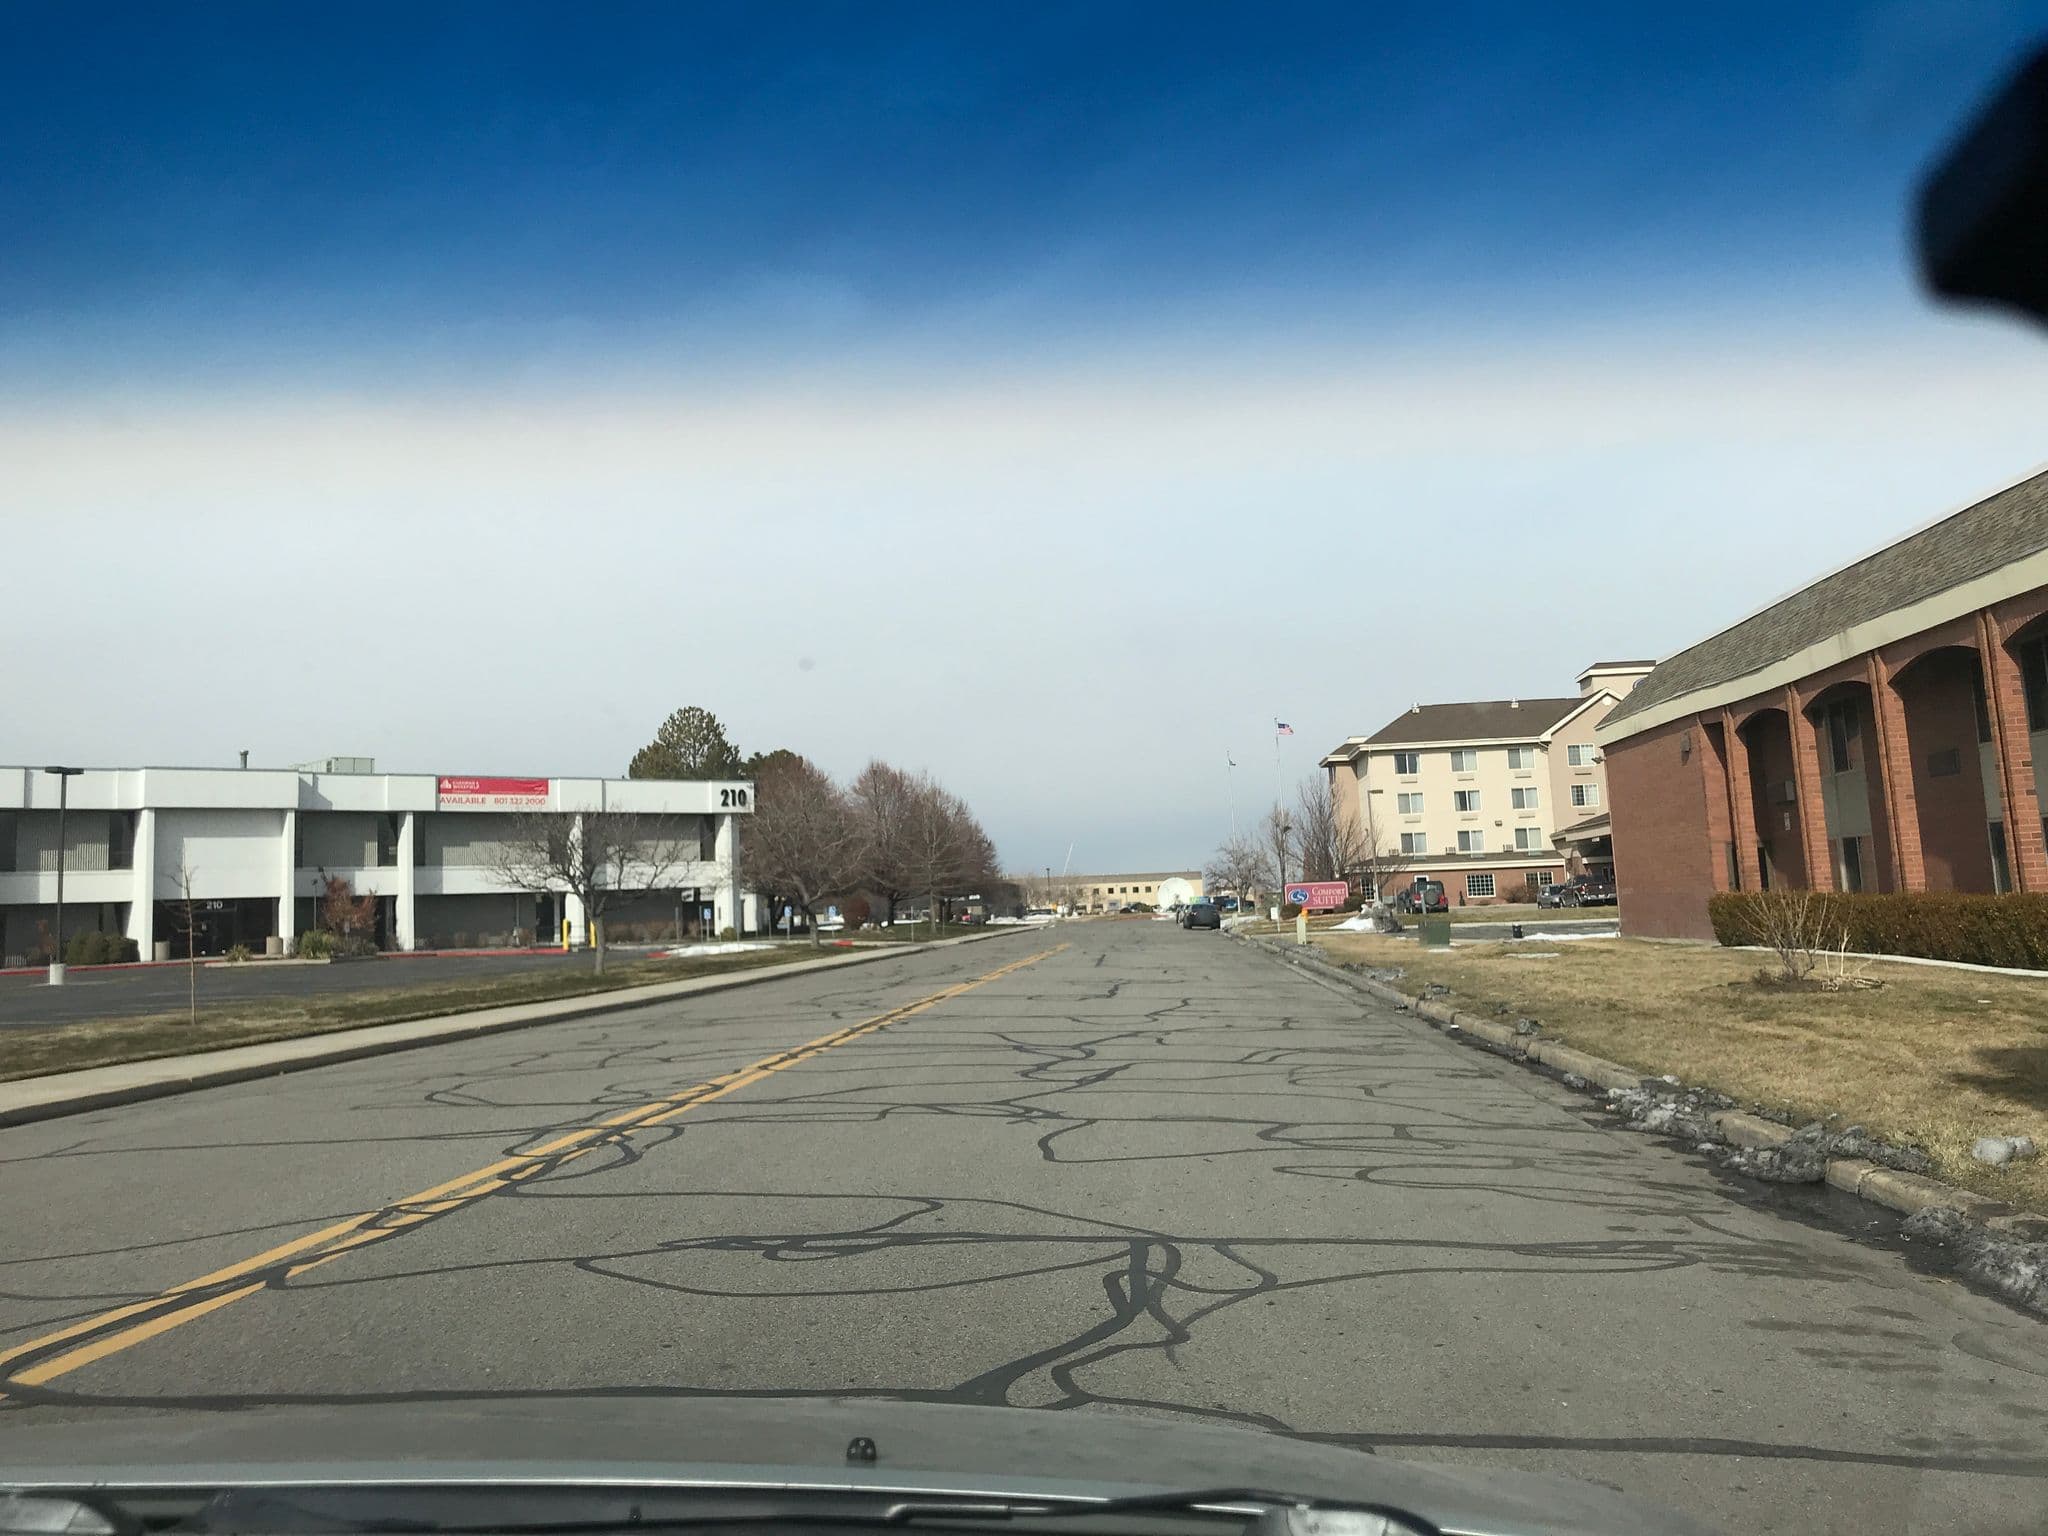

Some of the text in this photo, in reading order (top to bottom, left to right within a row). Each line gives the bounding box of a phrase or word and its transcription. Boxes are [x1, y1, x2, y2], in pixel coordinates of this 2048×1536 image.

[440, 797, 486, 805] AVAILABLE
[494, 797, 508, 805] 801
[720, 788, 747, 807] 210
